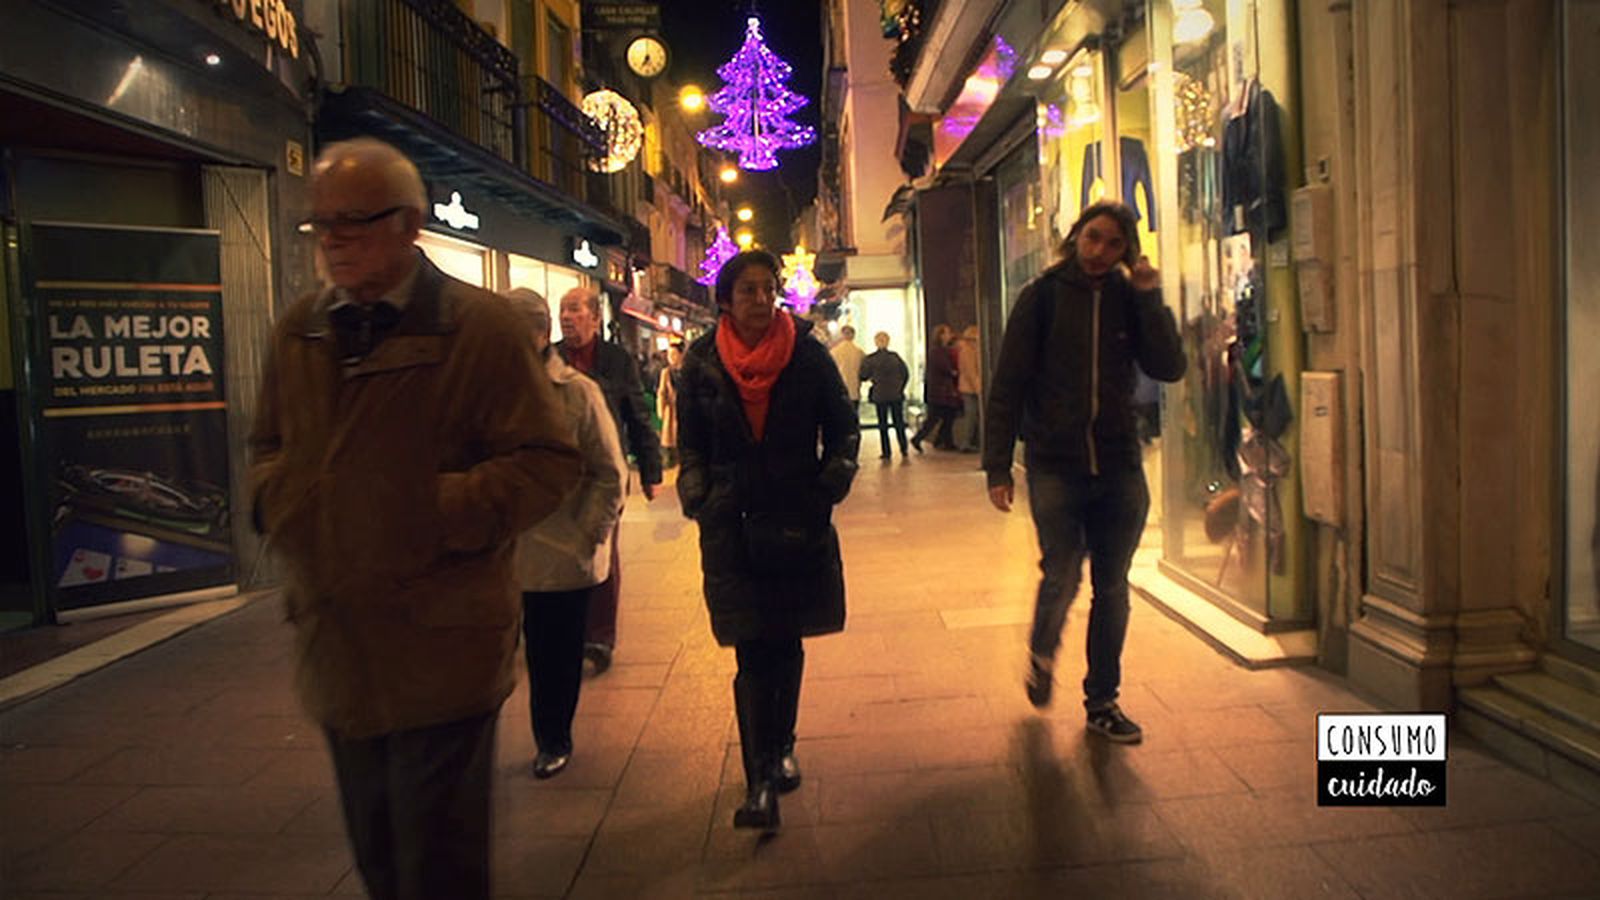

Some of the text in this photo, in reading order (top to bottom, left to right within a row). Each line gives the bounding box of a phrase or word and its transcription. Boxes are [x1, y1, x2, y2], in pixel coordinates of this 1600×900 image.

[222, 0, 299, 58] UEGOS
[49, 315, 211, 338] LA MEJOR
[52, 345, 212, 378] RULETA
[53, 385, 78, 397] DEL
[79, 384, 137, 396] MERCADO
